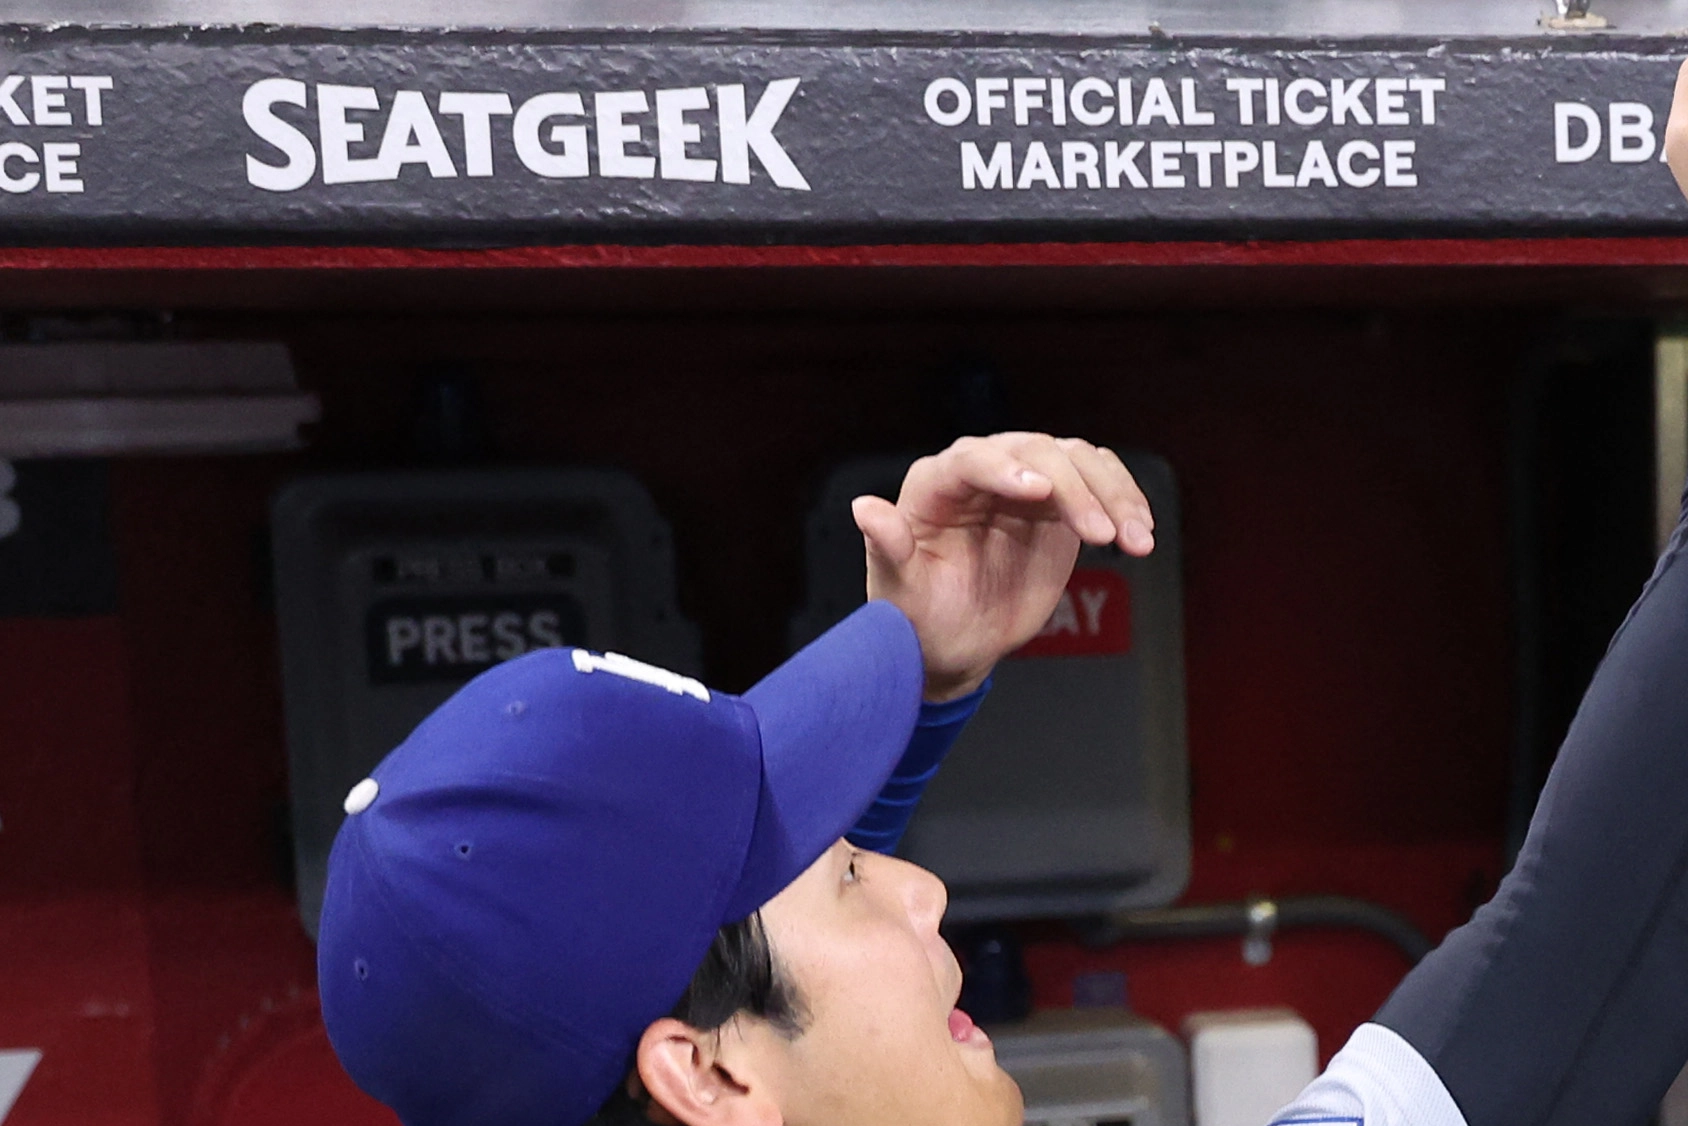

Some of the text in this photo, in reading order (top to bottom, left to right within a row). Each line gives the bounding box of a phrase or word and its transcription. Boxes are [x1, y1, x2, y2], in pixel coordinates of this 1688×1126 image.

[923, 77, 1446, 126] OFFICIAL TICKET
[242, 77, 812, 192] SEATGEEK
[1554, 102, 1668, 163] DB
[960, 140, 1418, 190] MARKETPLACE
[385, 609, 564, 665] PRESS
